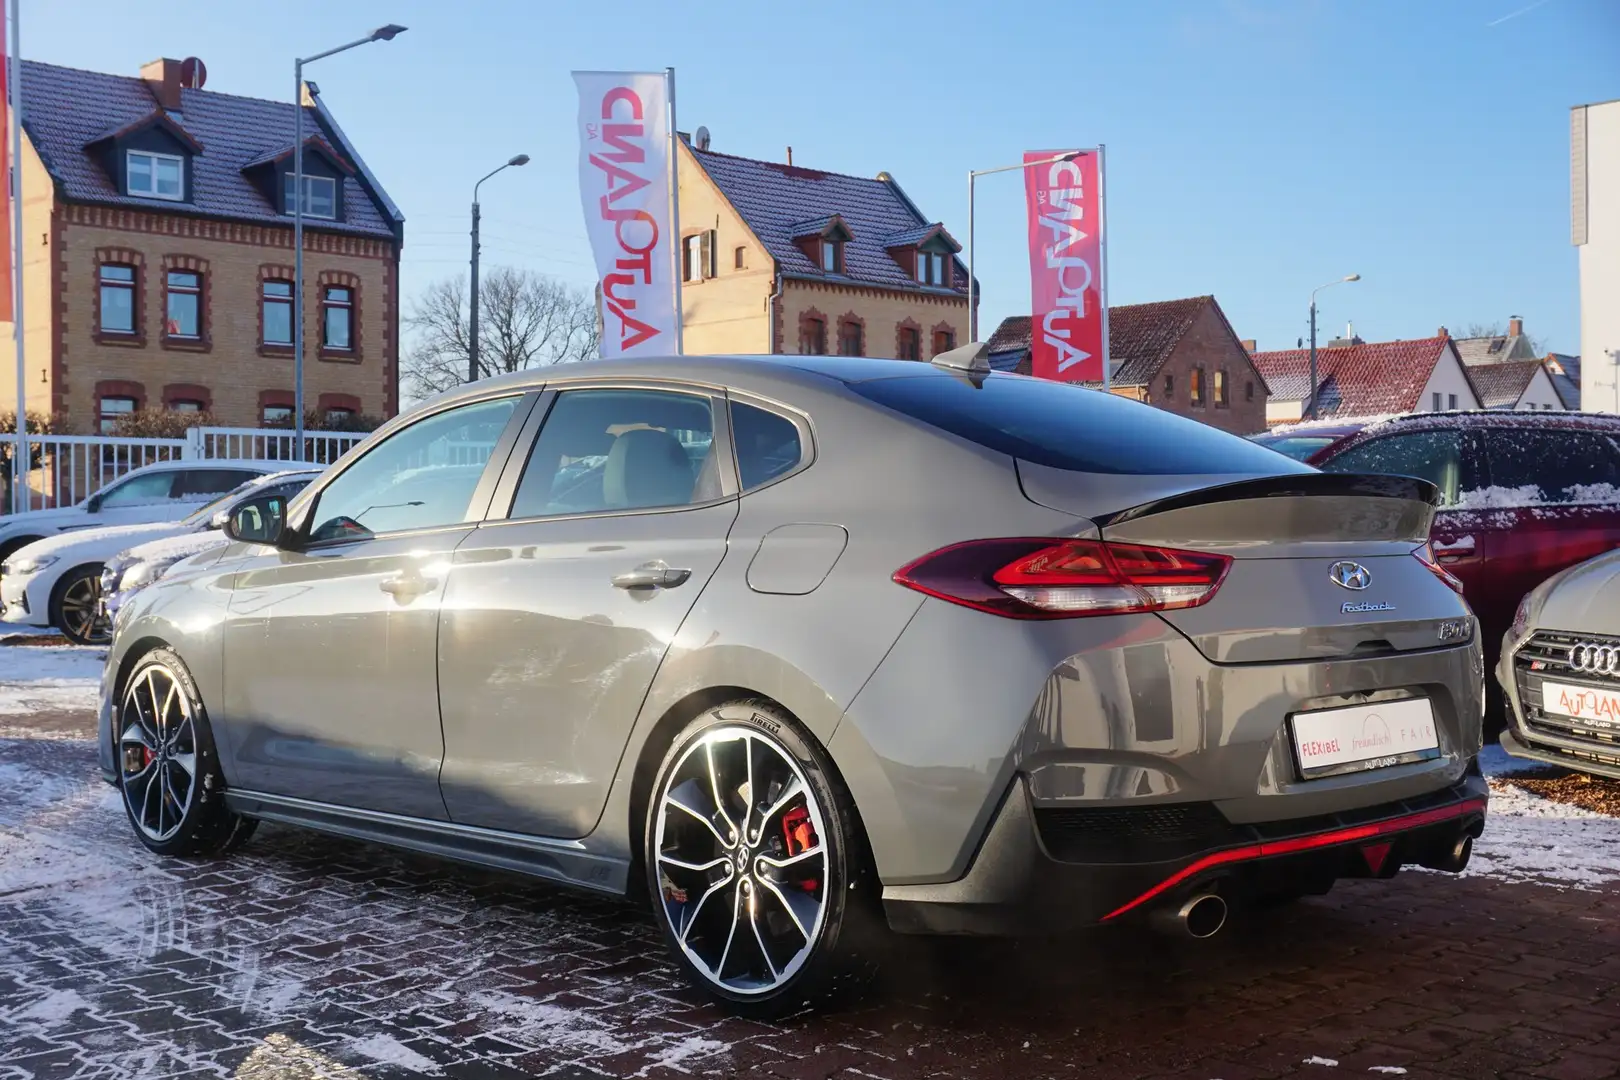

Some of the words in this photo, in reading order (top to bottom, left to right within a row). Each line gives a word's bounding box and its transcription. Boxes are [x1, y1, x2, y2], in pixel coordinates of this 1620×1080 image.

[1340, 601, 1396, 614] Fastback
[750, 712, 781, 734] PIRELLI
[1302, 737, 1341, 757] FLEXIBEL
[1400, 725, 1432, 742] FAIR
[1364, 757, 1397, 770] AUTOLAND
